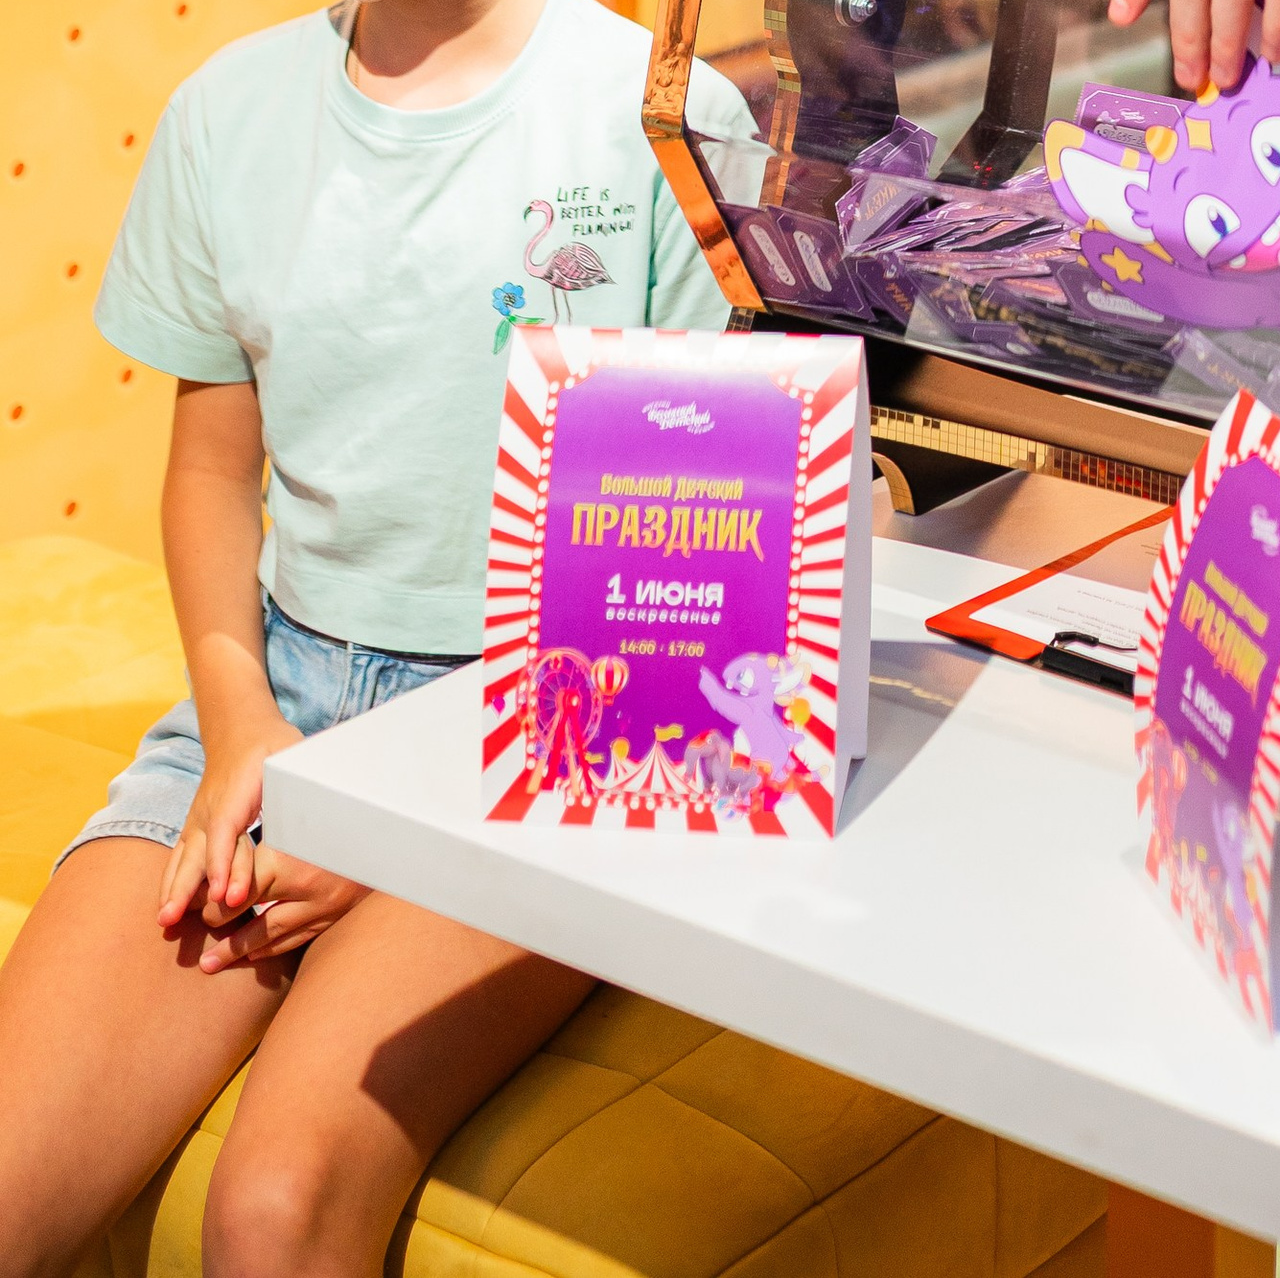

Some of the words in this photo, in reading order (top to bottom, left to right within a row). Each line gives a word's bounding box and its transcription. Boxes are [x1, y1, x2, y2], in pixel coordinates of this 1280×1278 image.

[557, 186, 589, 202] LIFE
[600, 188, 610, 201] IS
[561, 205, 605, 219] BETTER
[571, 502, 764, 563] ПРАЗДНИК
[606, 573, 626, 604] 1
[606, 607, 721, 625] воскресенье
[619, 639, 656, 655] 14:00
[667, 641, 705, 657] 17:00
